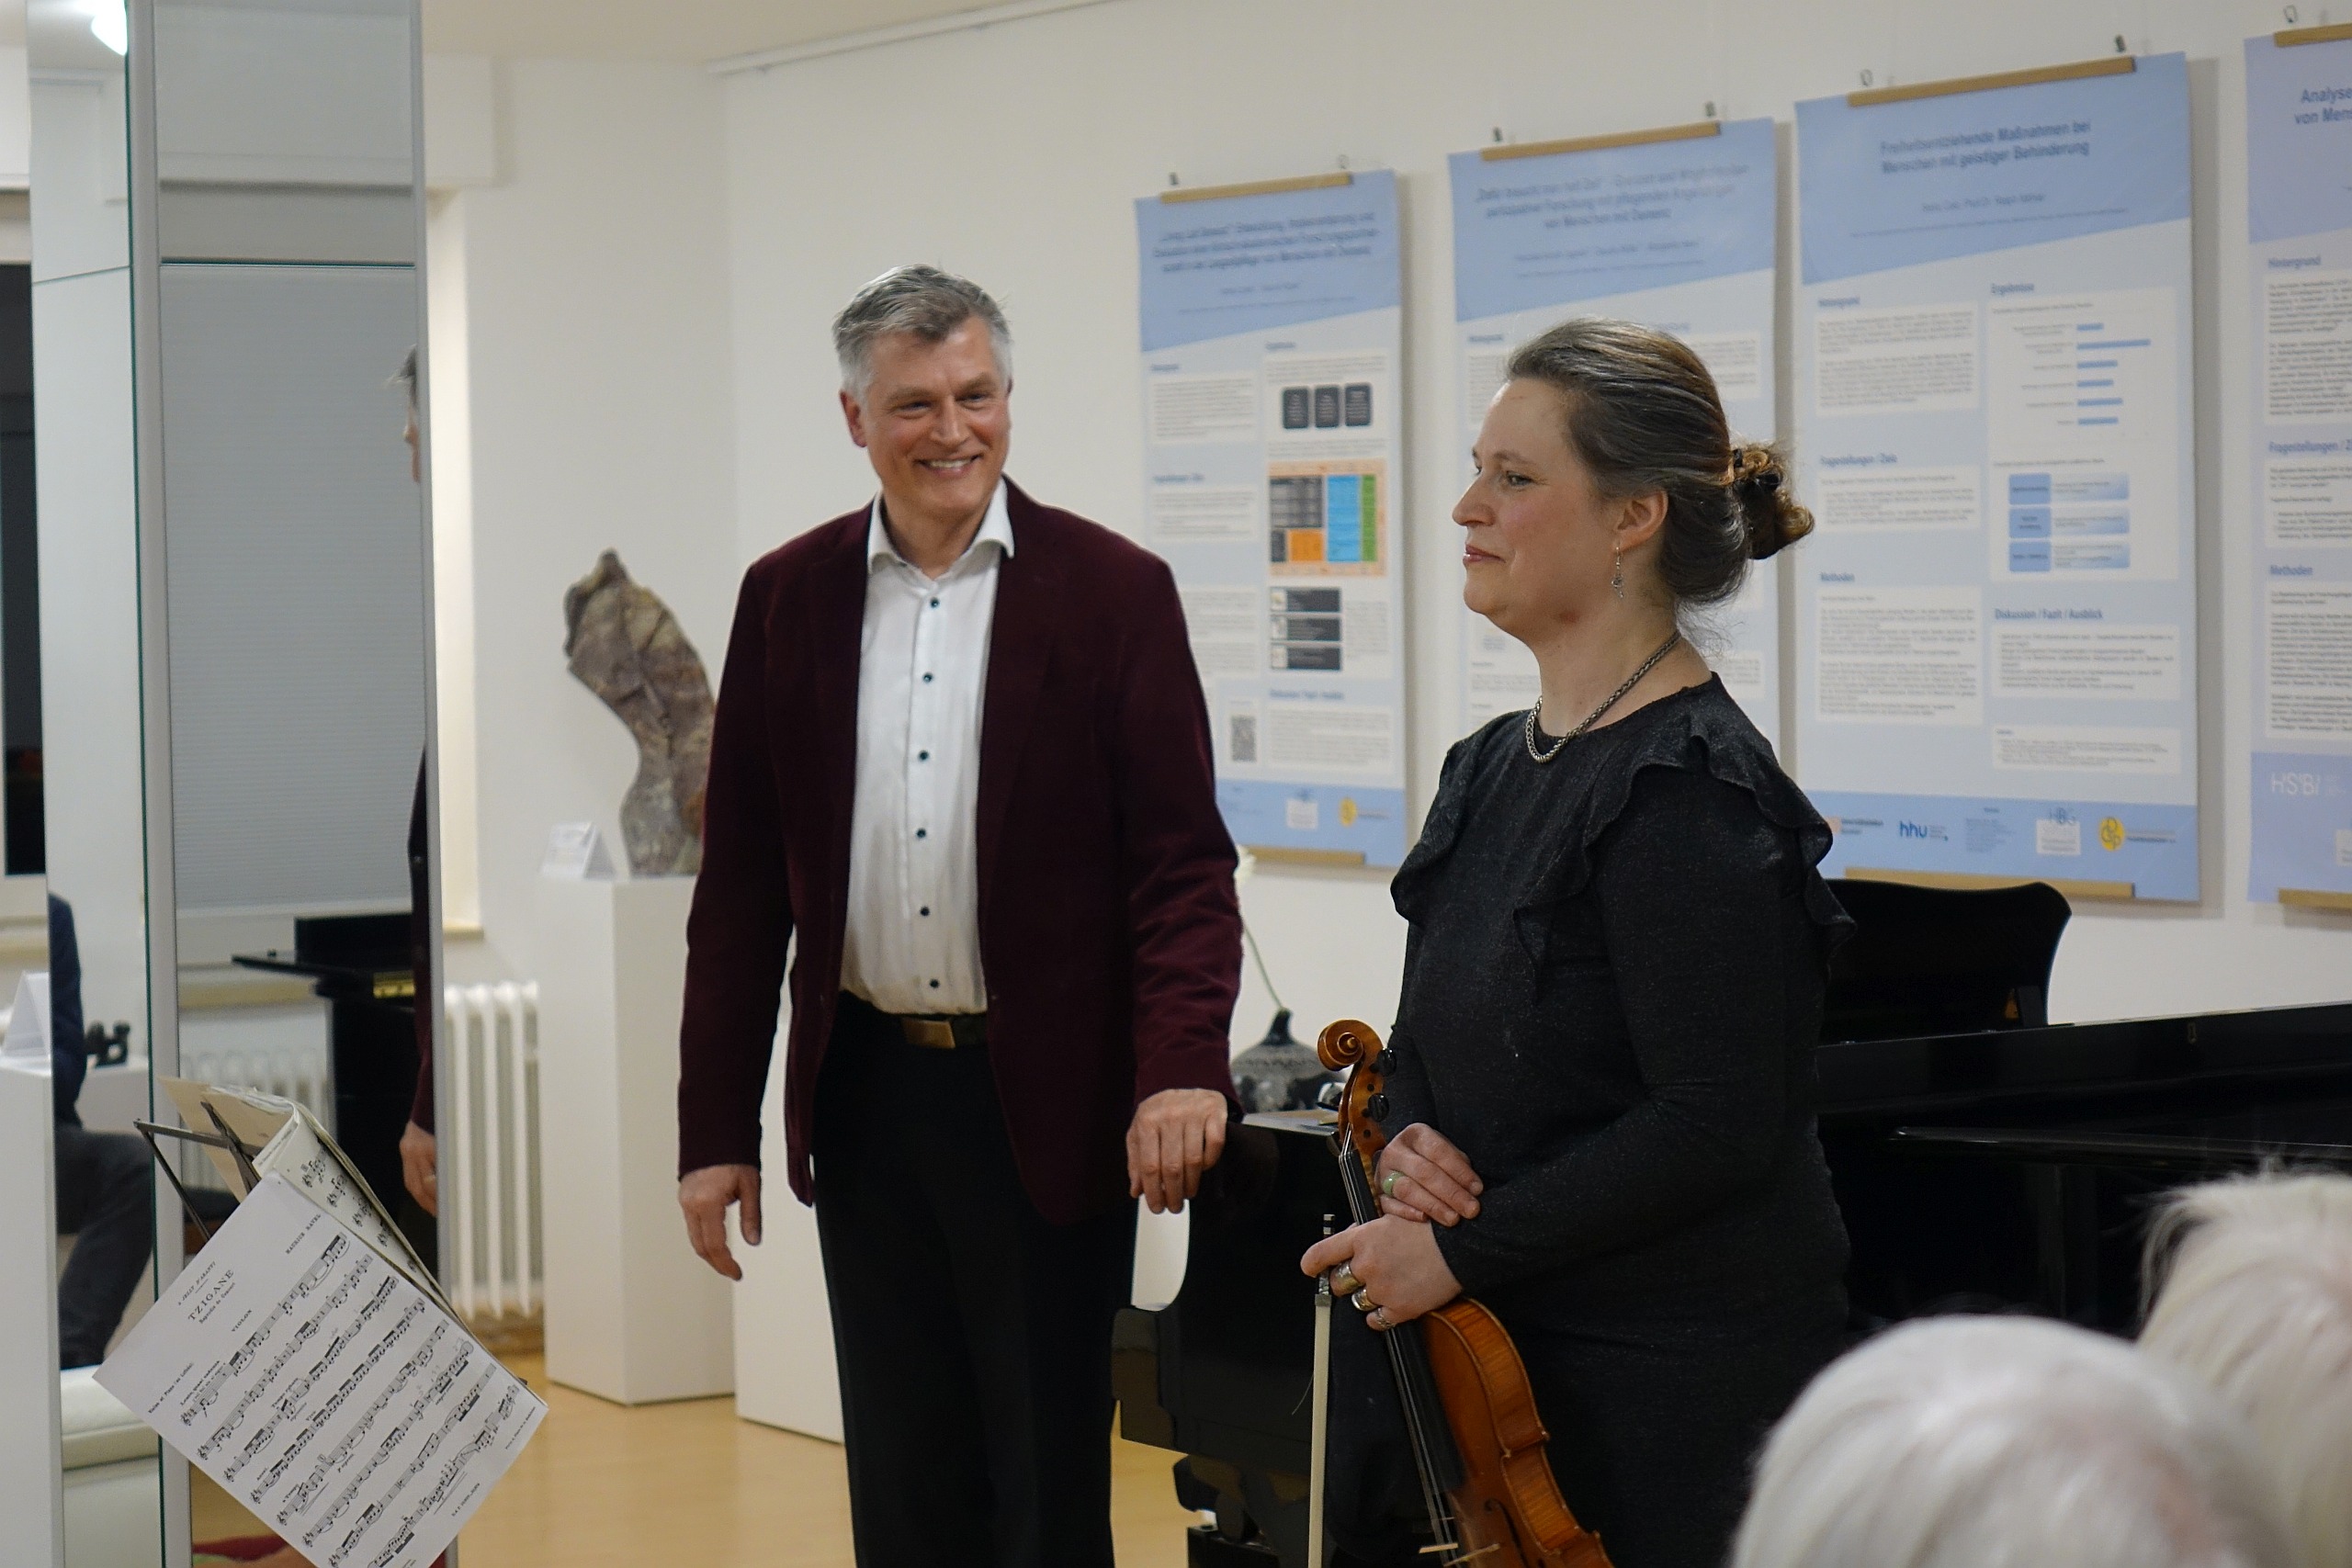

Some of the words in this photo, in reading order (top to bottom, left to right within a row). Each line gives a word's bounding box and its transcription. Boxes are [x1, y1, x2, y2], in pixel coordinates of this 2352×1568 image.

[2294, 112, 2318, 124] von
[1899, 819, 1928, 838] hhu
[305, 1213, 321, 1229] RAVEL
[187, 1270, 233, 1320] TZIGANE
[232, 1309, 252, 1332] VIOLON
